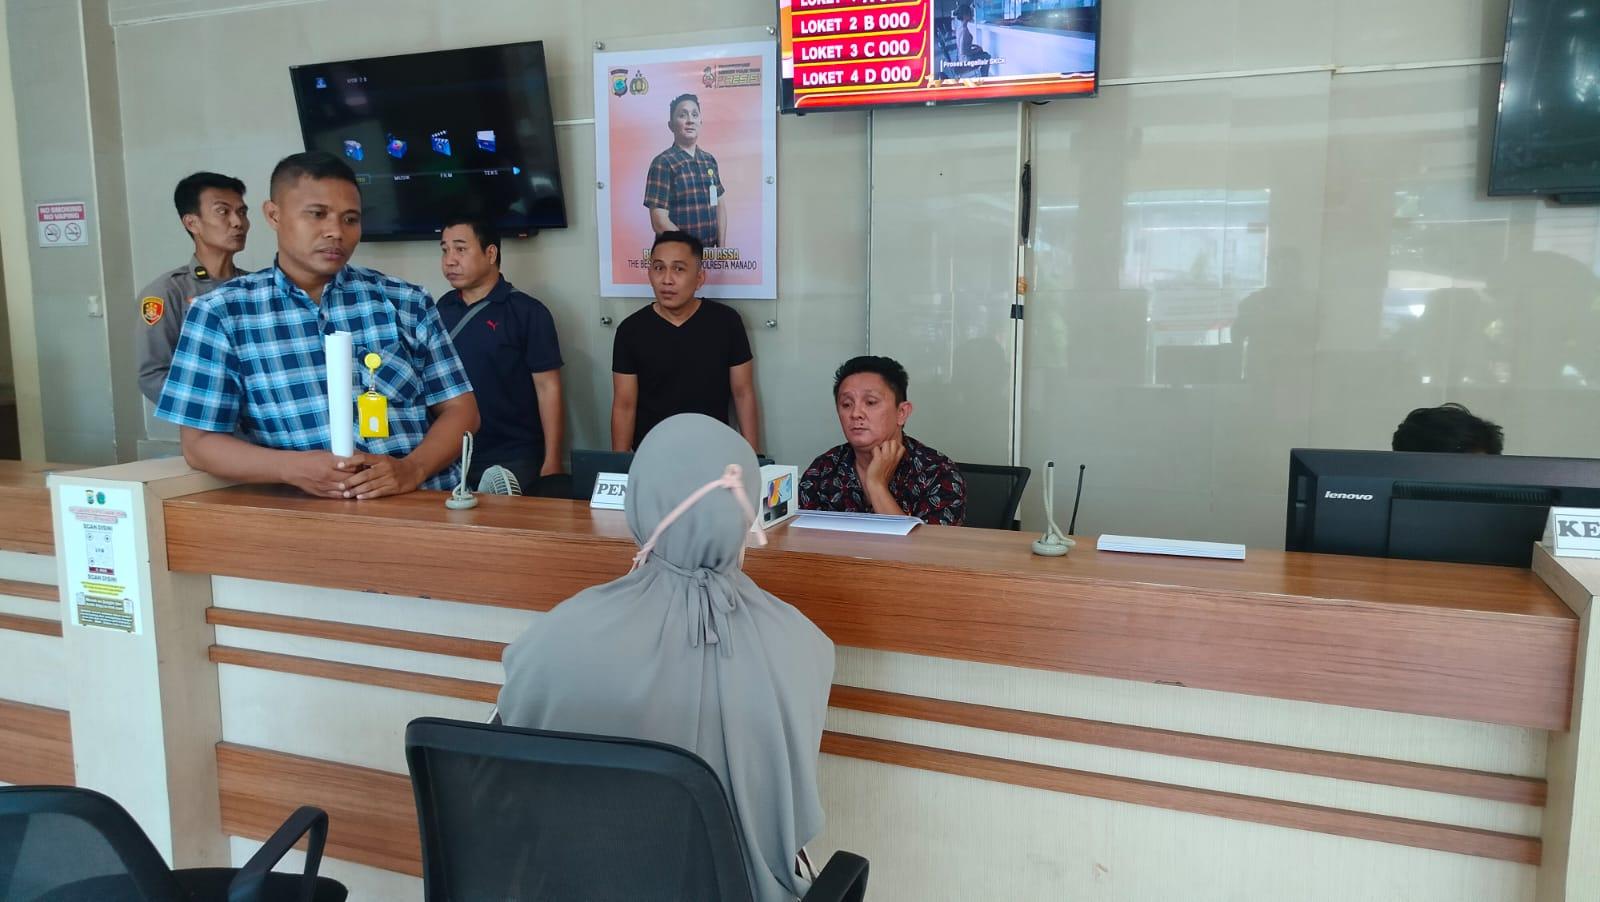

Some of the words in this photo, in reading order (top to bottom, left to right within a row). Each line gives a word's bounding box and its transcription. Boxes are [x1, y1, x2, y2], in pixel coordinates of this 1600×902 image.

[801, 18, 842, 33] LOKET
[849, 17, 857, 30] 2
[864, 15, 874, 30] B
[879, 12, 910, 29] 000
[802, 45, 843, 60] LOKET
[850, 44, 858, 57] 3
[864, 42, 875, 57] C
[879, 39, 910, 56] 000
[802, 71, 844, 86] LOKET
[850, 70, 859, 83] 4
[865, 69, 876, 83] D
[881, 66, 911, 82] 000
[717, 248, 740, 260] ASSA
[627, 259, 639, 269] THE
[730, 260, 757, 270] MANADO
[1324, 490, 1373, 500] lenovo
[1558, 520, 1600, 538] KE
